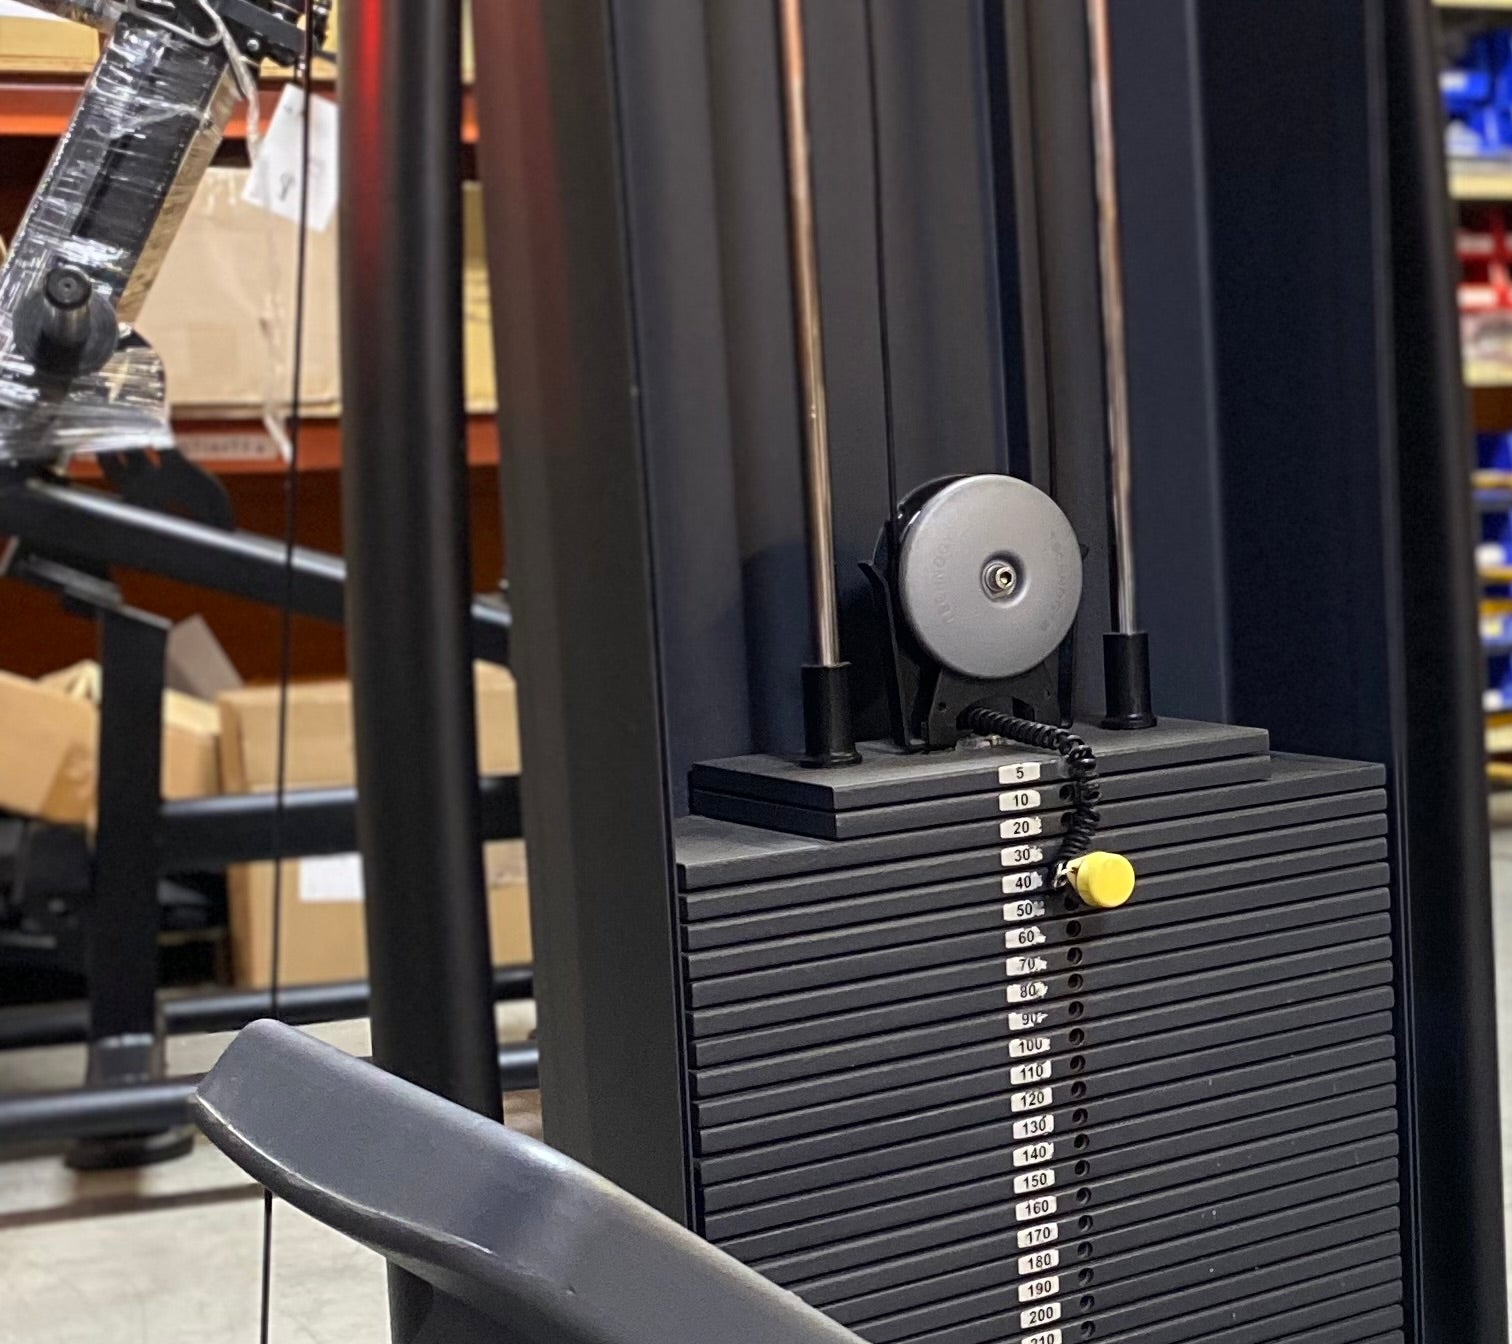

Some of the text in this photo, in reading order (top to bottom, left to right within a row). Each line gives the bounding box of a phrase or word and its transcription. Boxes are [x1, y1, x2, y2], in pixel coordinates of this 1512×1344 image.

[1016, 767, 1024, 779] 5
[1012, 793, 1029, 807] 10
[1013, 821, 1030, 835] 20
[1014, 848, 1030, 862] 30
[1015, 875, 1031, 889] 40
[1016, 903, 1033, 917] 50
[1018, 930, 1035, 944] 60
[1019, 958, 1036, 972] 70
[1020, 985, 1036, 998] 80
[1018, 1039, 1043, 1054] 100
[1020, 1064, 1044, 1079] 110
[1019, 1092, 1045, 1107] 120
[1022, 1117, 1047, 1135] 130
[1022, 1145, 1047, 1161] 140
[1023, 1173, 1048, 1188] 150
[1025, 1200, 1049, 1215] 160
[1027, 1226, 1051, 1243] 170
[1027, 1253, 1052, 1269] 180
[1028, 1280, 1052, 1296] 190
[1029, 1307, 1054, 1324] 200
